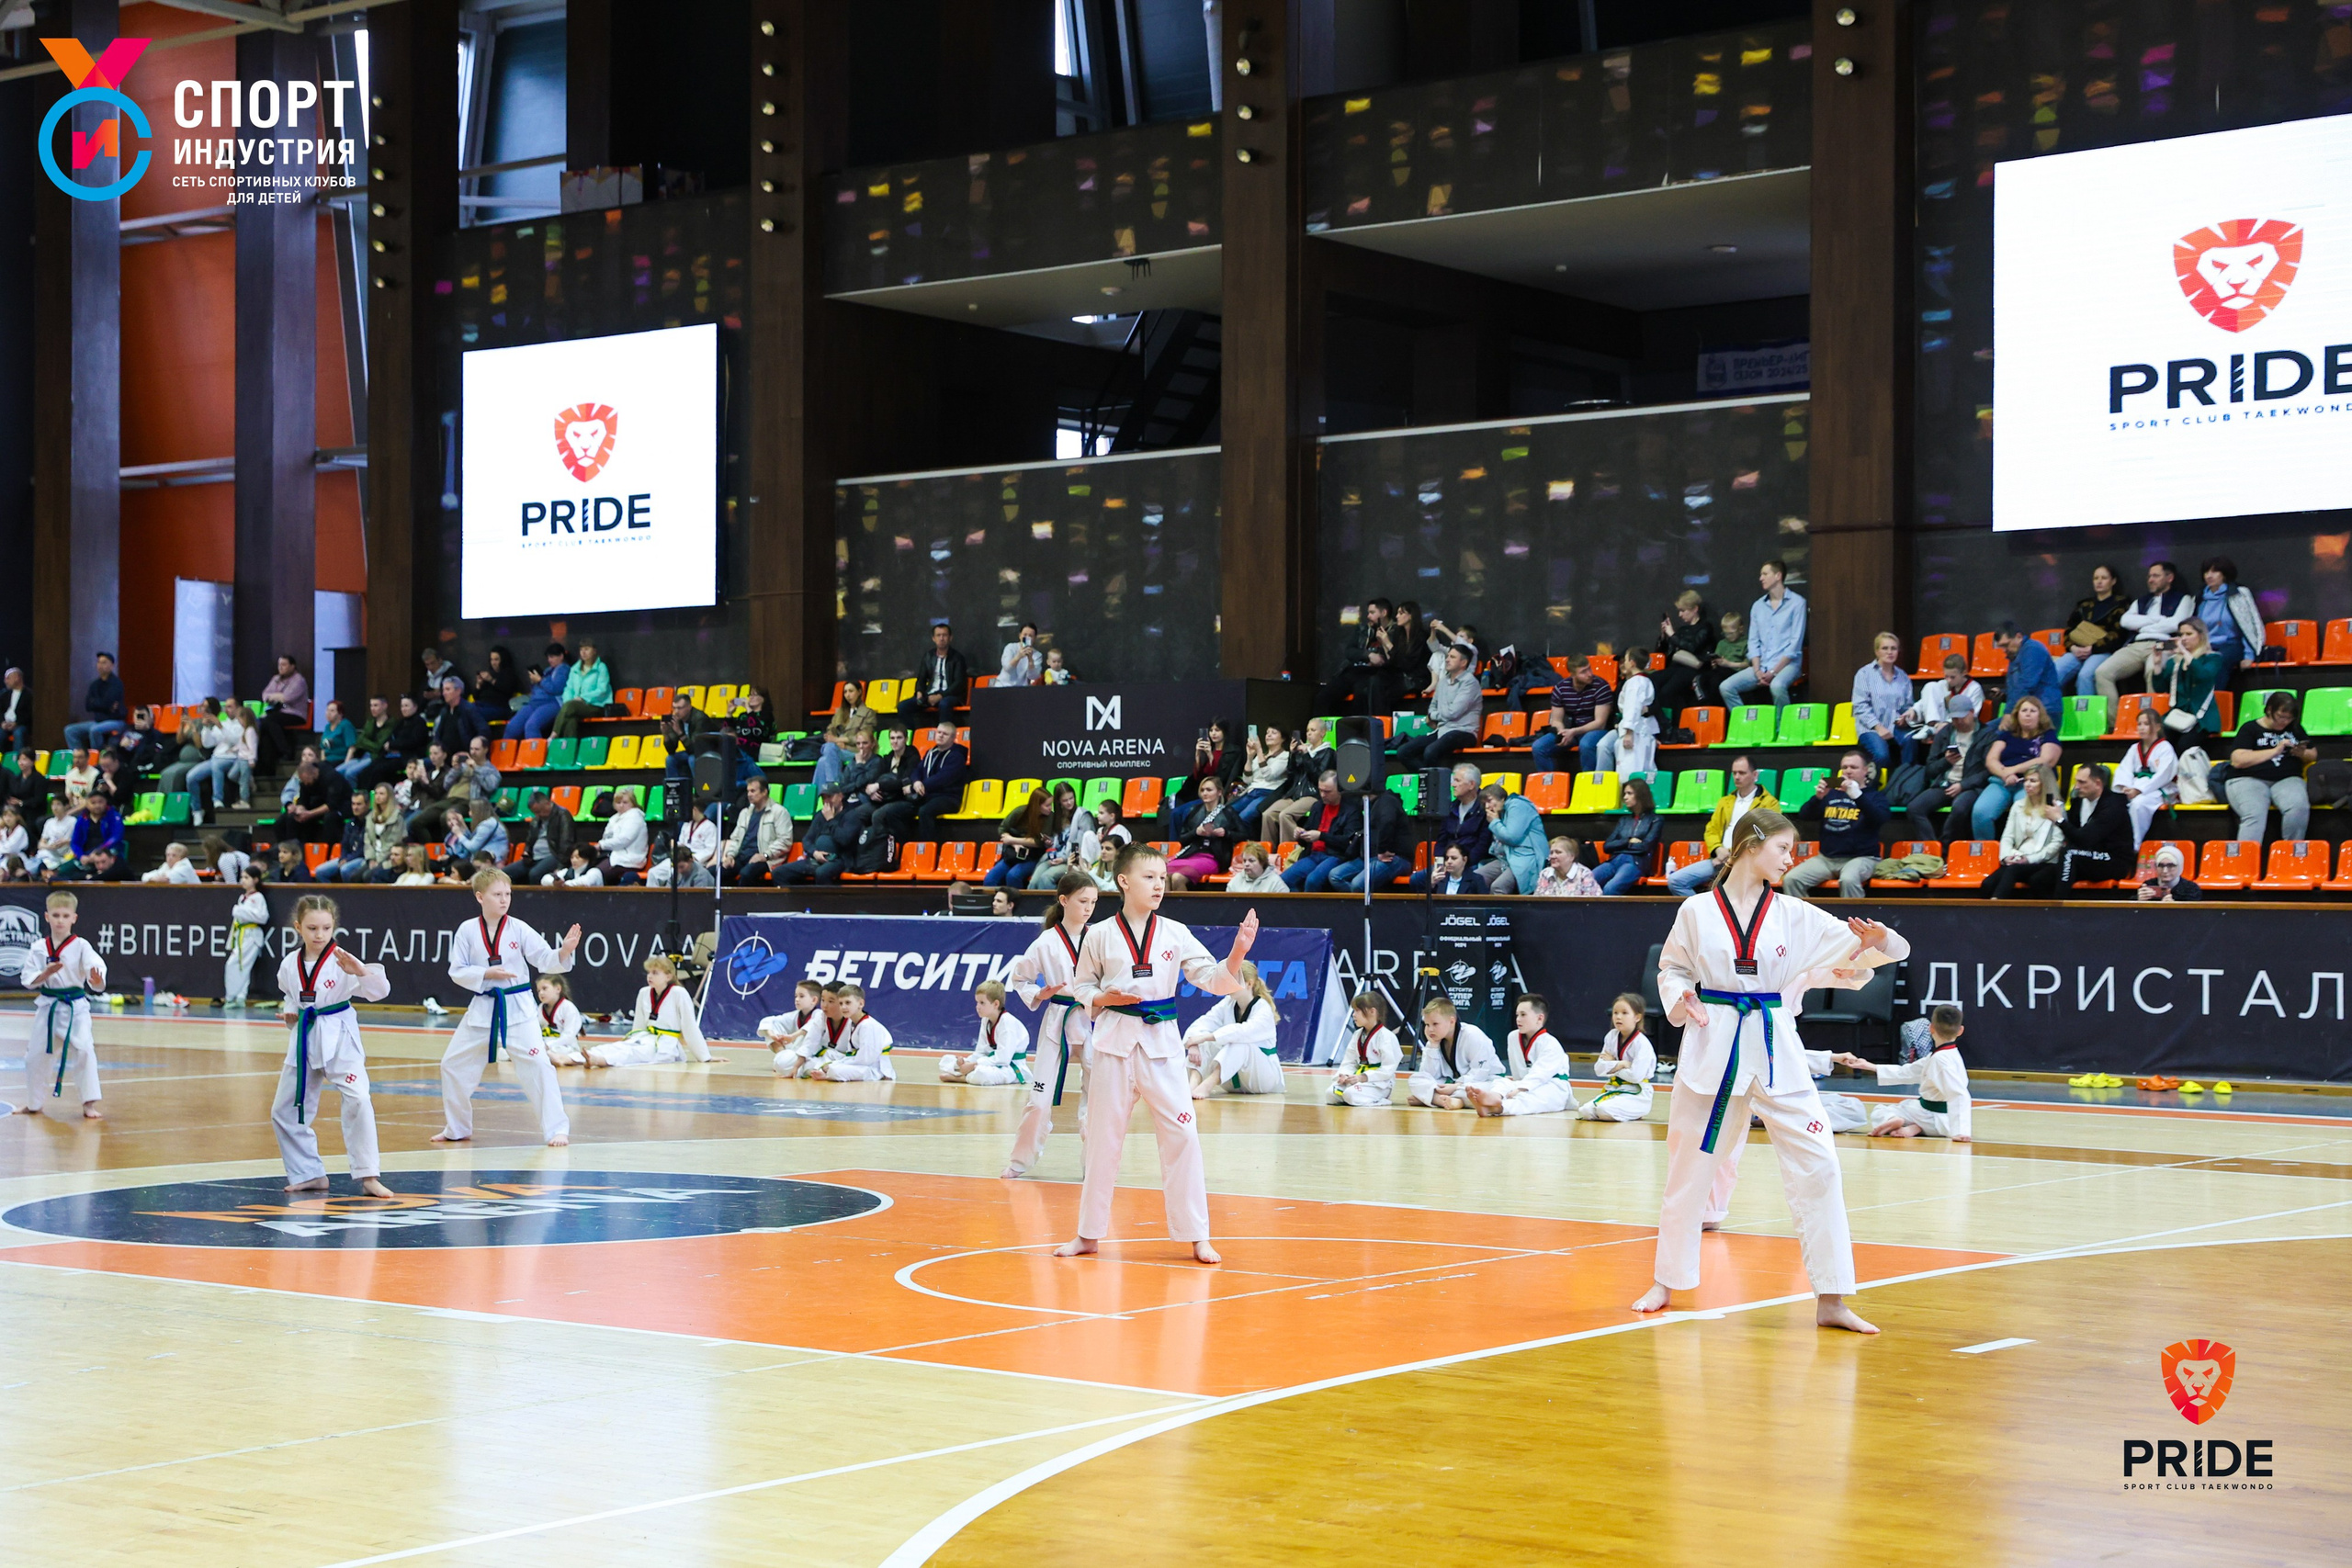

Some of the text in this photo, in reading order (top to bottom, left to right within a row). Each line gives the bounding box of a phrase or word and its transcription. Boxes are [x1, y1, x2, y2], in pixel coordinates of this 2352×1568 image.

[2109, 344, 2352, 413] PRIDE
[2109, 419, 2170, 431] SPORT
[2182, 413, 2232, 425] CLUB
[522, 493, 651, 536] PRIDE
[1043, 738, 1165, 757] NOVA ARENA
[1057, 760, 1151, 769] СПОРТИВНЫЙ КОМПЛЕКС
[1824, 807, 1860, 820] VINTAGE
[1440, 914, 1481, 926] JÖGEL
[804, 950, 1027, 992] БЕТСИТИ
[1711, 1078, 1733, 1131] TAEKWONDO
[130, 1183, 617, 1223] NOVA
[254, 1187, 763, 1237] ARENA
